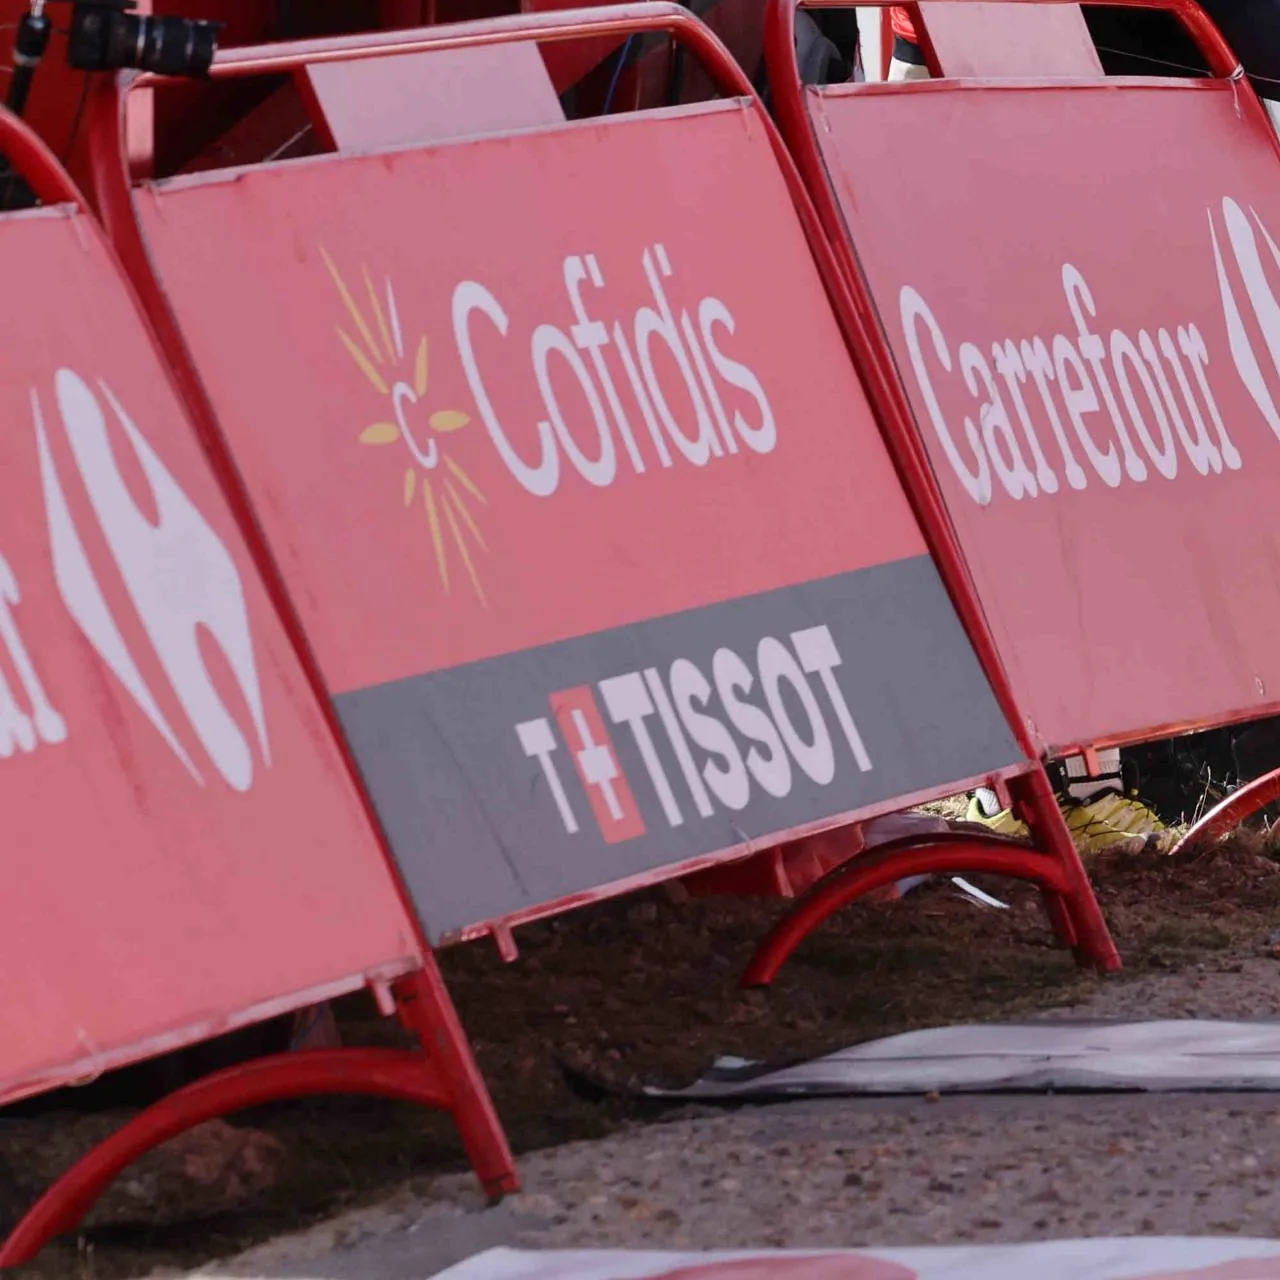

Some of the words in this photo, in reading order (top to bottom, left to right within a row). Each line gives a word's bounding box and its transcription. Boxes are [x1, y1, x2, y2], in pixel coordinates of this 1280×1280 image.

[451, 243, 777, 497] Cofidis
[898, 263, 1243, 506] Carrefour
[598, 624, 873, 828] TISSOT
